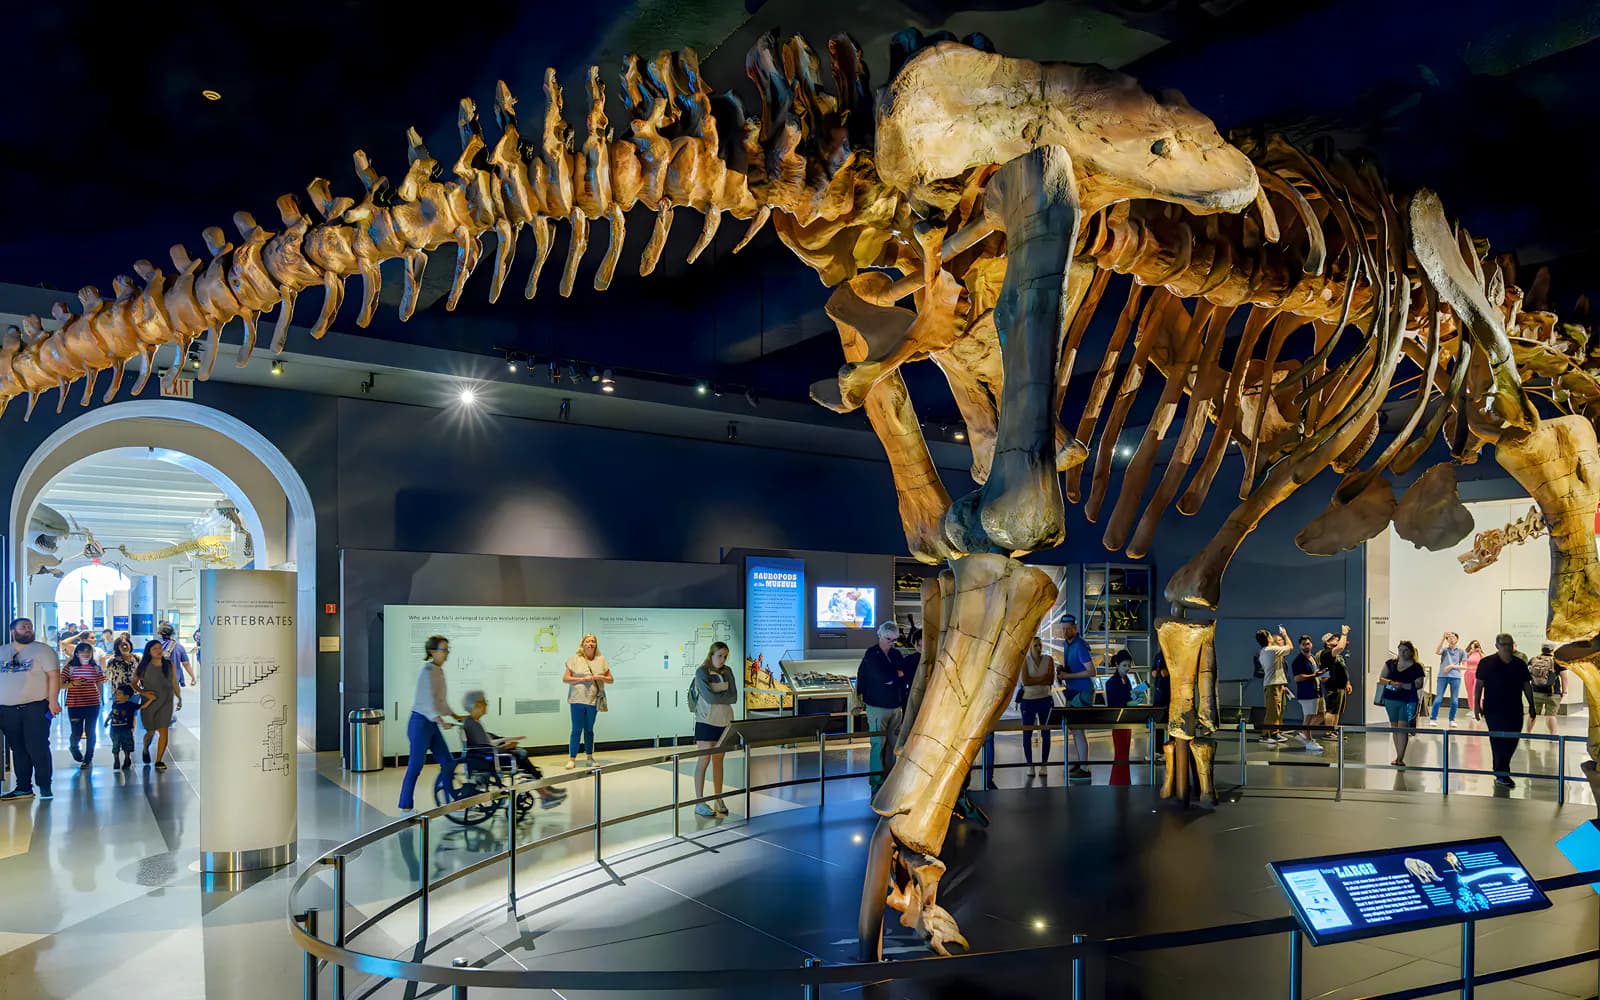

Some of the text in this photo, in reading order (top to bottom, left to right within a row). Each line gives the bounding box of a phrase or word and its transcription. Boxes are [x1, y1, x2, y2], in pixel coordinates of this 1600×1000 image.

[753, 572, 797, 580] SAUROPODS
[765, 580, 797, 588] MUSEUM
[208, 615, 293, 626] VERTEBRATES
[1333, 863, 1379, 879] LARGE
